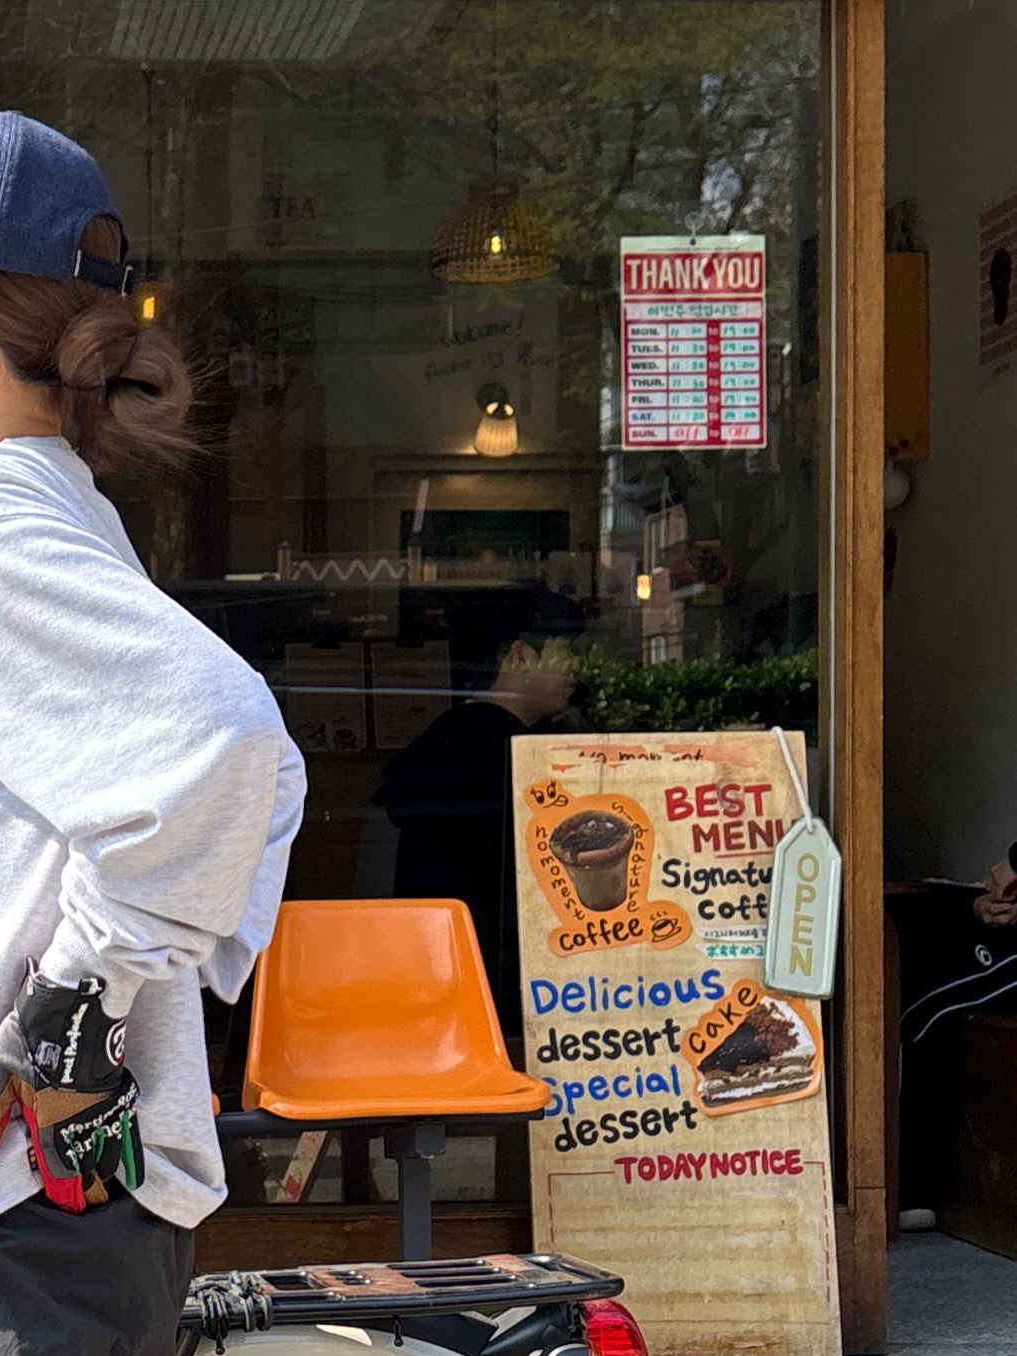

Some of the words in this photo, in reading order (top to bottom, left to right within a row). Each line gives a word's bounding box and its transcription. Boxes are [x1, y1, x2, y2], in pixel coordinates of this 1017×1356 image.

[626, 257, 709, 290] THANK
[712, 256, 760, 289] YOU
[631, 362, 659, 370] WED.
[631, 379, 664, 387] THUR.
[631, 396, 652, 404] FRI.
[632, 413, 655, 421] SAT.
[632, 430, 657, 438] SUN.
[664, 783, 772, 822] BEST
[661, 858, 773, 895] Signatu
[789, 853, 820, 977] OPEN
[559, 918, 644, 951] coffee
[531, 969, 725, 1014] Delicious
[688, 985, 758, 1055] cake
[537, 1018, 681, 1063] dessert
[542, 1064, 681, 1116] Special
[554, 1100, 698, 1152] dessert
[614, 1153, 705, 1183] TODAY
[710, 1149, 804, 1177] NOTICE
